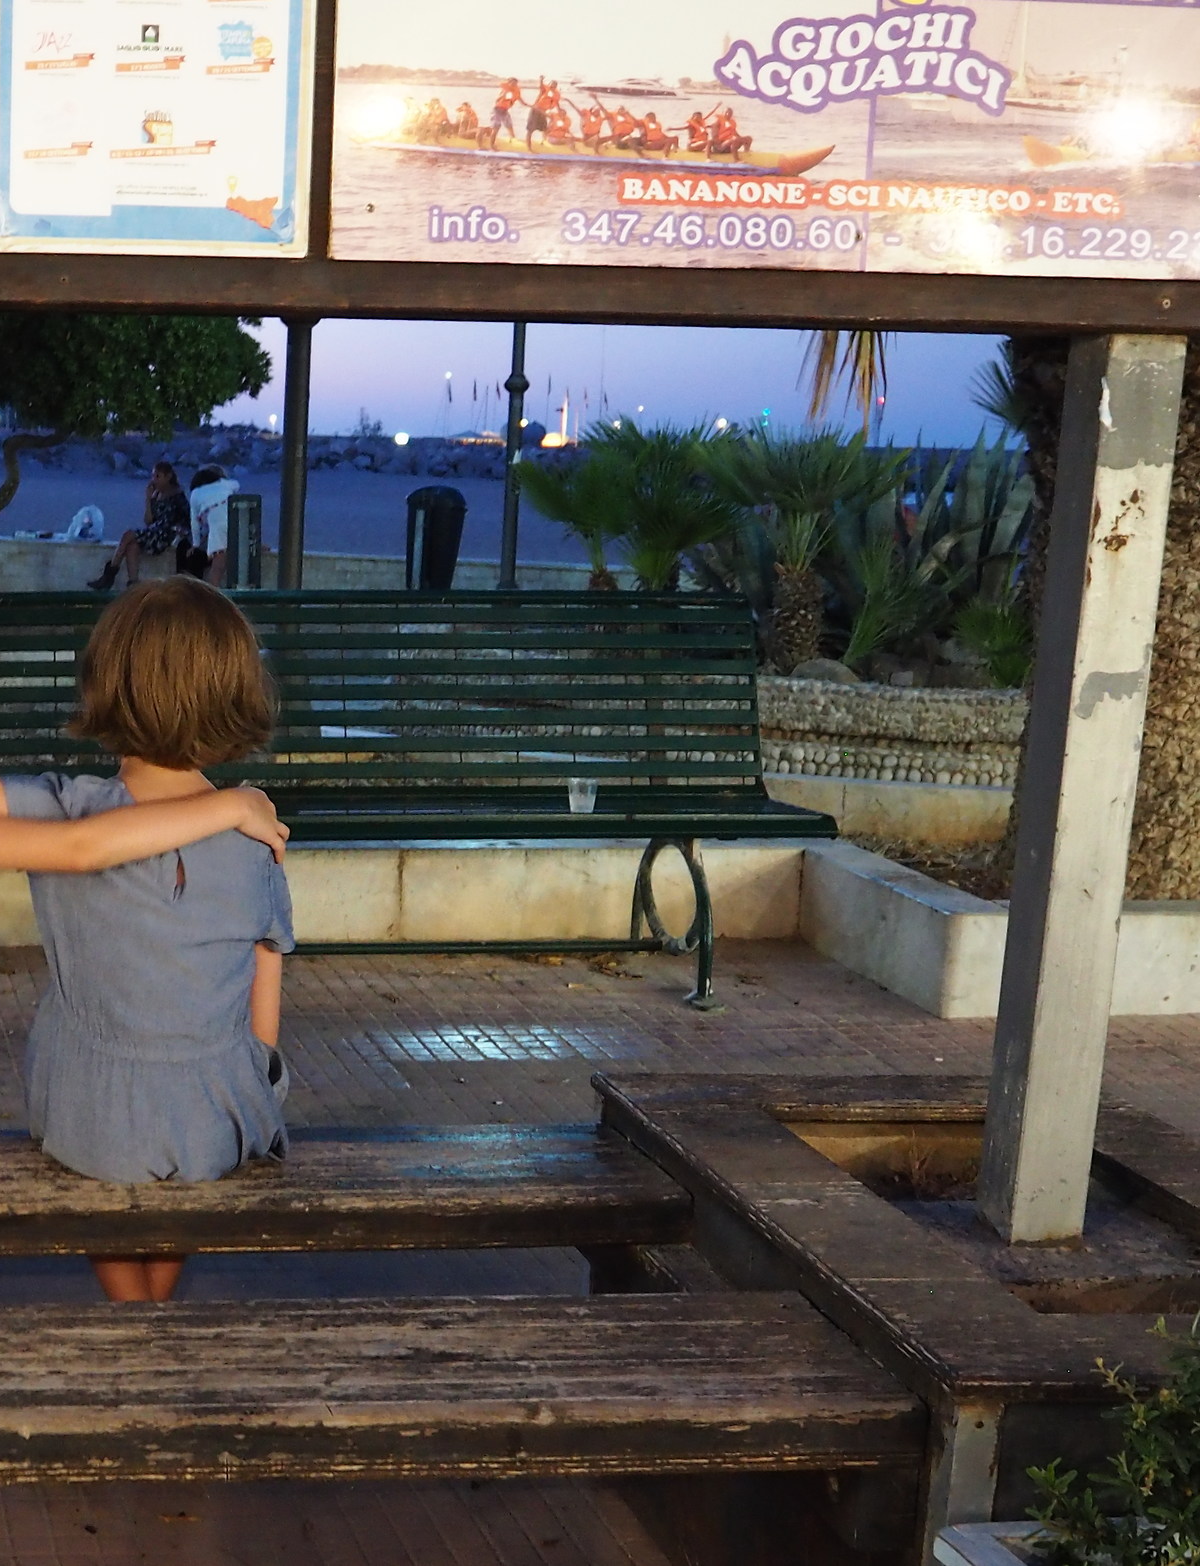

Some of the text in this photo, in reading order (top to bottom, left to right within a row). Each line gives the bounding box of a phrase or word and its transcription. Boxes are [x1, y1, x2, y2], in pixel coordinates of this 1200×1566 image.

[779, 13, 969, 61] GIOCHI
[720, 47, 1005, 110] ACQUATICI
[622, 178, 806, 206] BANANONE
[828, 183, 881, 207] SCI
[887, 186, 1031, 211] NAUTICO
[431, 209, 518, 241] info.
[564, 213, 857, 250] 347.46.080.60
